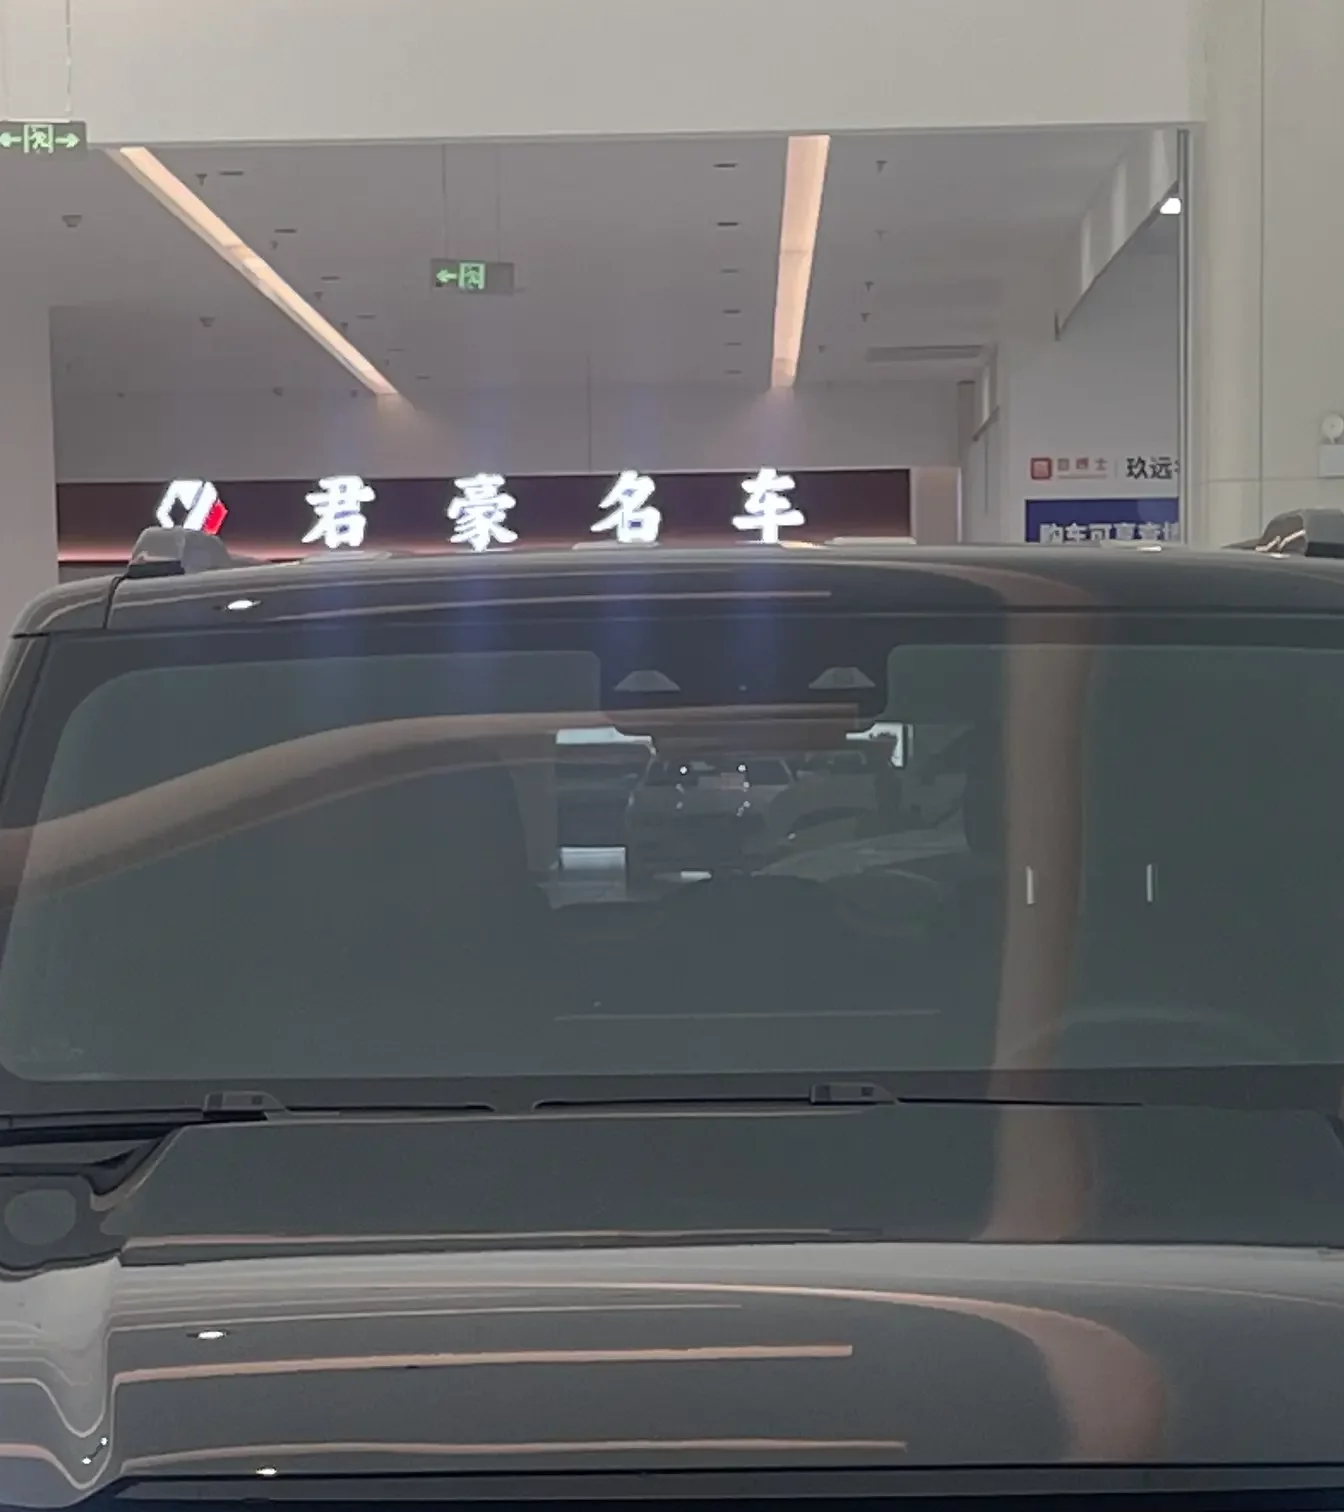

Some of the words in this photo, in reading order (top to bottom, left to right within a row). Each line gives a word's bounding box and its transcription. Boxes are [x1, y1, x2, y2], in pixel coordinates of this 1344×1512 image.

[1126, 456, 1180, 479] 玖远
[301, 467, 805, 552] 君豪名车
